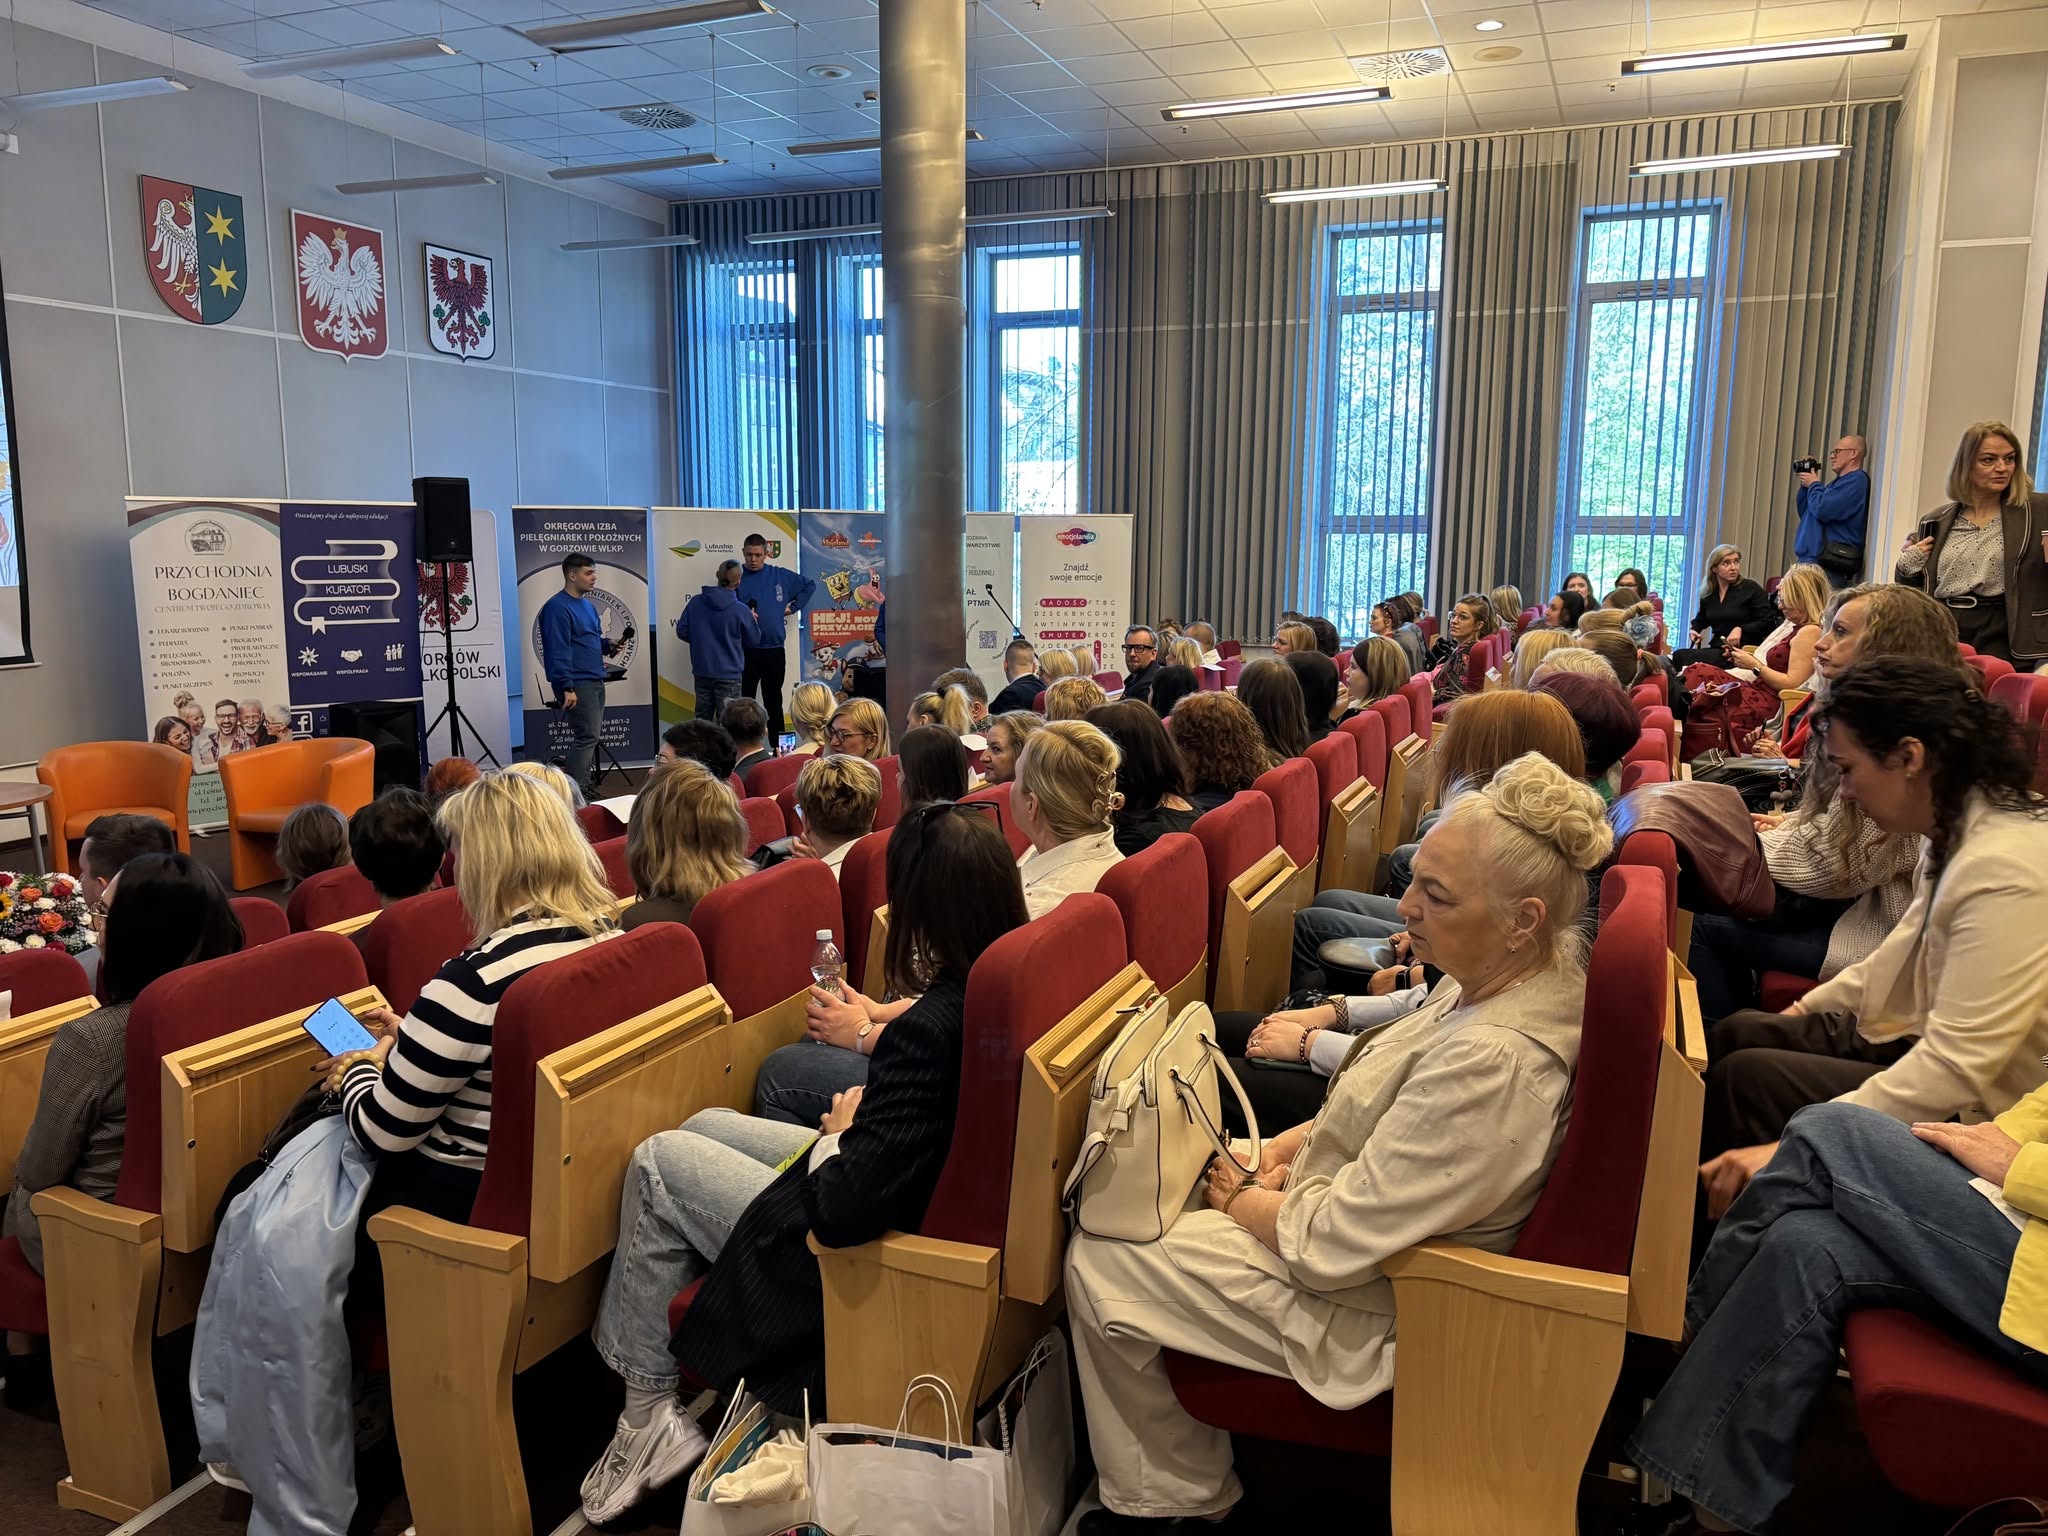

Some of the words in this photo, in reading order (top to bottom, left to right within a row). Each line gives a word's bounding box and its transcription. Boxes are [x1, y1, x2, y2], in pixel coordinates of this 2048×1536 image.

[544, 522, 595, 532] OKRĘGOWA
[597, 522, 617, 530] IZBA
[520, 533, 582, 543] PIELĘGNIAREK
[589, 532, 641, 542] POŁOŻNYCH
[549, 544, 597, 552] GORZOWIE
[598, 544, 624, 553] WLKP.
[154, 565, 273, 580] PRZYCHODNIA
[327, 564, 369, 574] LUBUSKI
[1063, 562, 1089, 573] Znajdź
[1049, 574, 1073, 583] swoje
[1074, 574, 1103, 583] emocje
[168, 586, 265, 601] BOGDANIEC
[325, 585, 371, 595] KURATOR
[967, 599, 991, 607] PTMR
[328, 604, 371, 615] OŚWIATY
[812, 612, 852, 624] HEJ!
[422, 647, 480, 666] ORÓW
